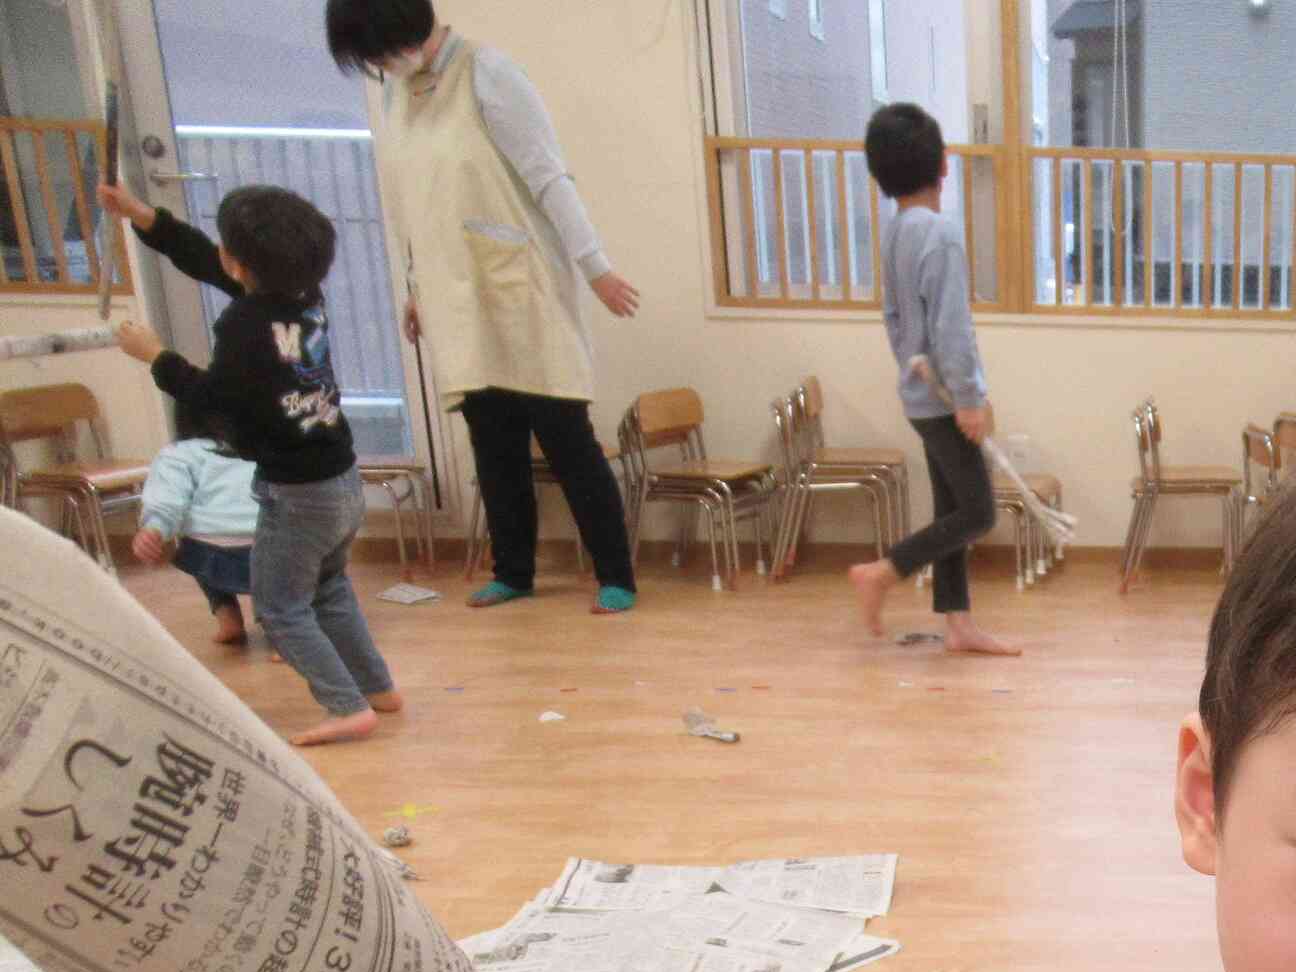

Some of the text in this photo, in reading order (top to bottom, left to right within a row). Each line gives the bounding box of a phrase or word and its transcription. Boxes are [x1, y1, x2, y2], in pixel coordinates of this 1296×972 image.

[0, 739, 133, 871] しくみ
[42, 730, 216, 933] 腕時計の
[112, 767, 242, 968] 世界一わかりやすい
